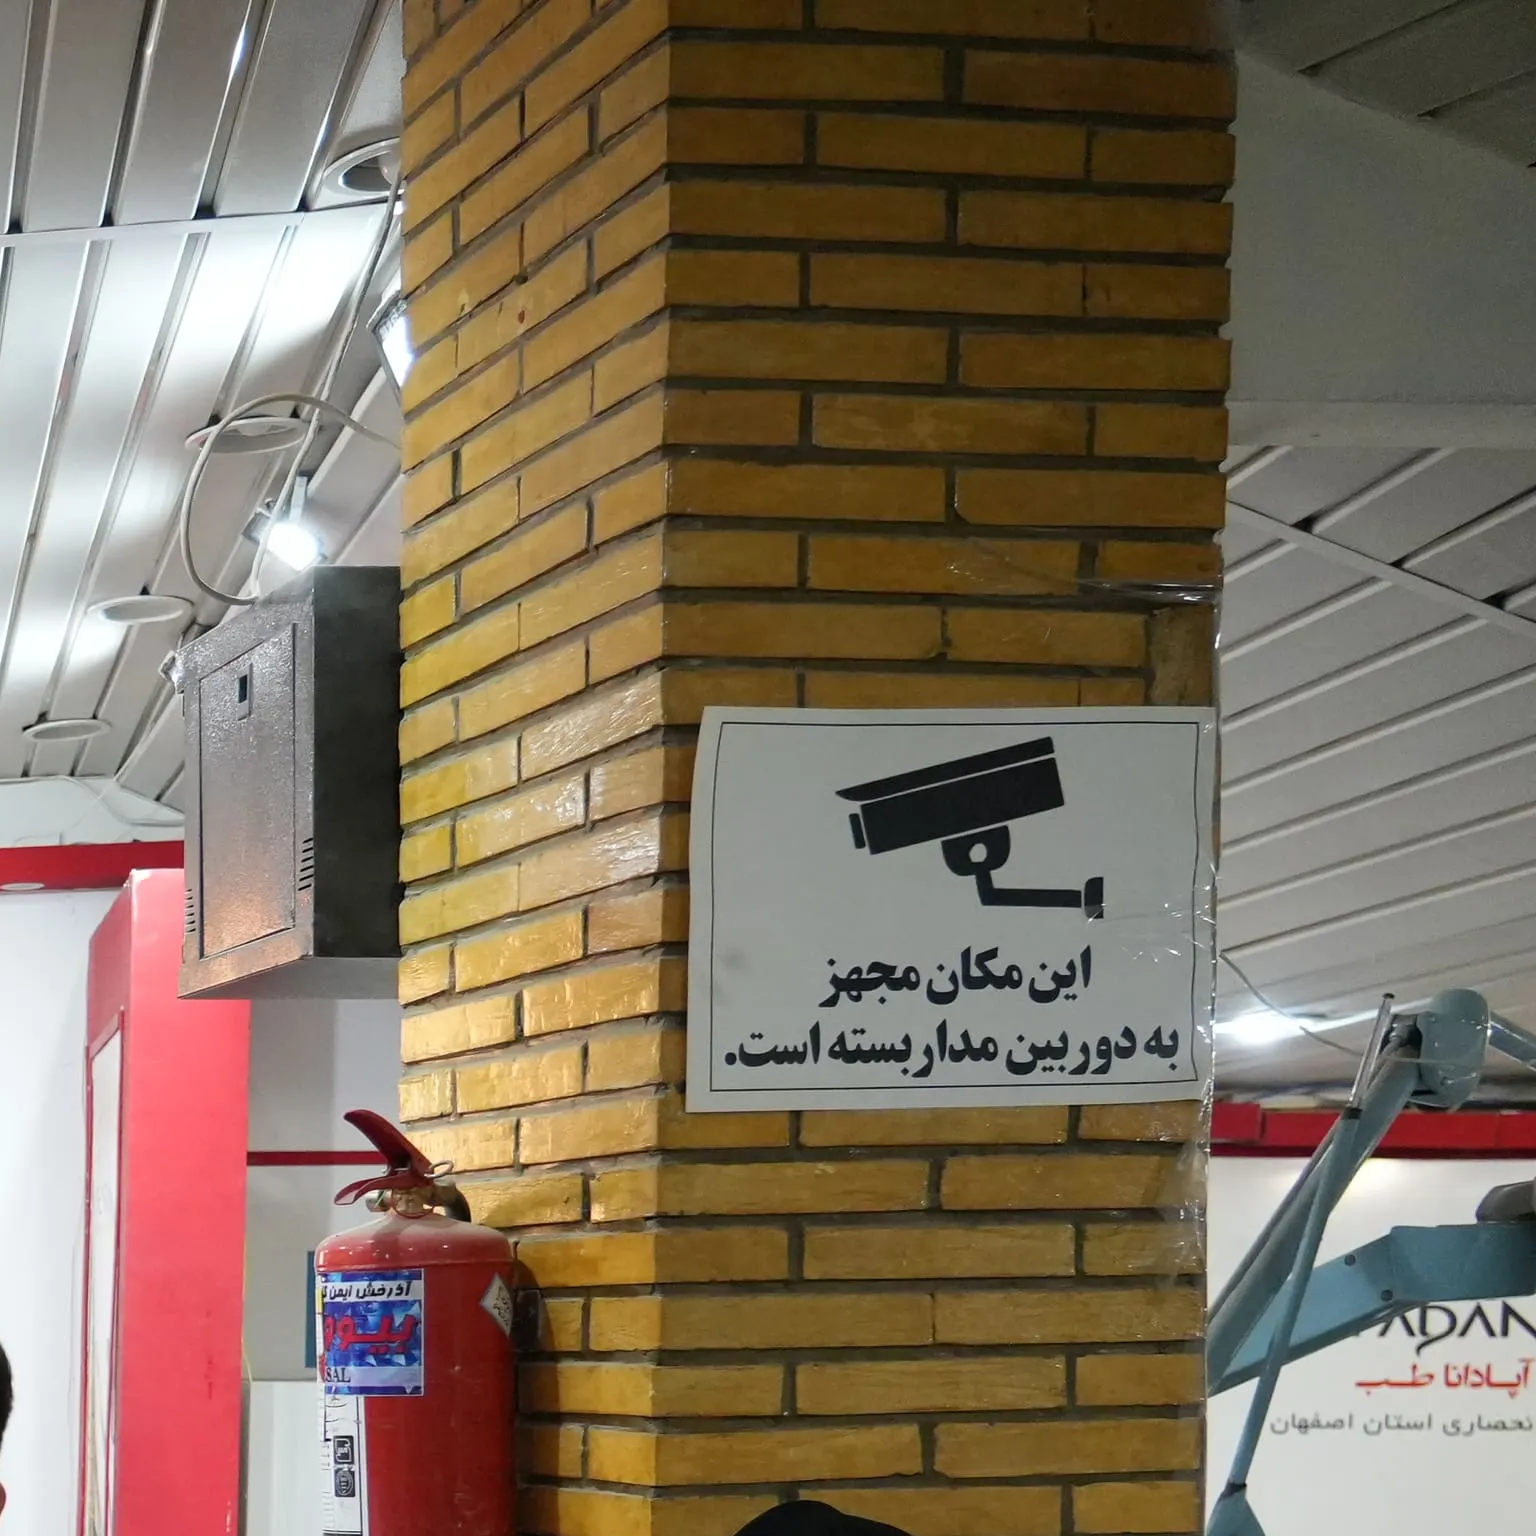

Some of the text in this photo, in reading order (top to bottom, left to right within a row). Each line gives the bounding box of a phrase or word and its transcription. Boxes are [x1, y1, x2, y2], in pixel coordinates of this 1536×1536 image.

[817, 945, 1093, 1008] این مکان مجهز
[723, 1022, 822, 1069] است.
[1004, 1024, 1136, 1078] دوربین
[1143, 1026, 1180, 1072] به
[1270, 1411, 1353, 1436] اصفهان
[1363, 1412, 1432, 1436] استان
